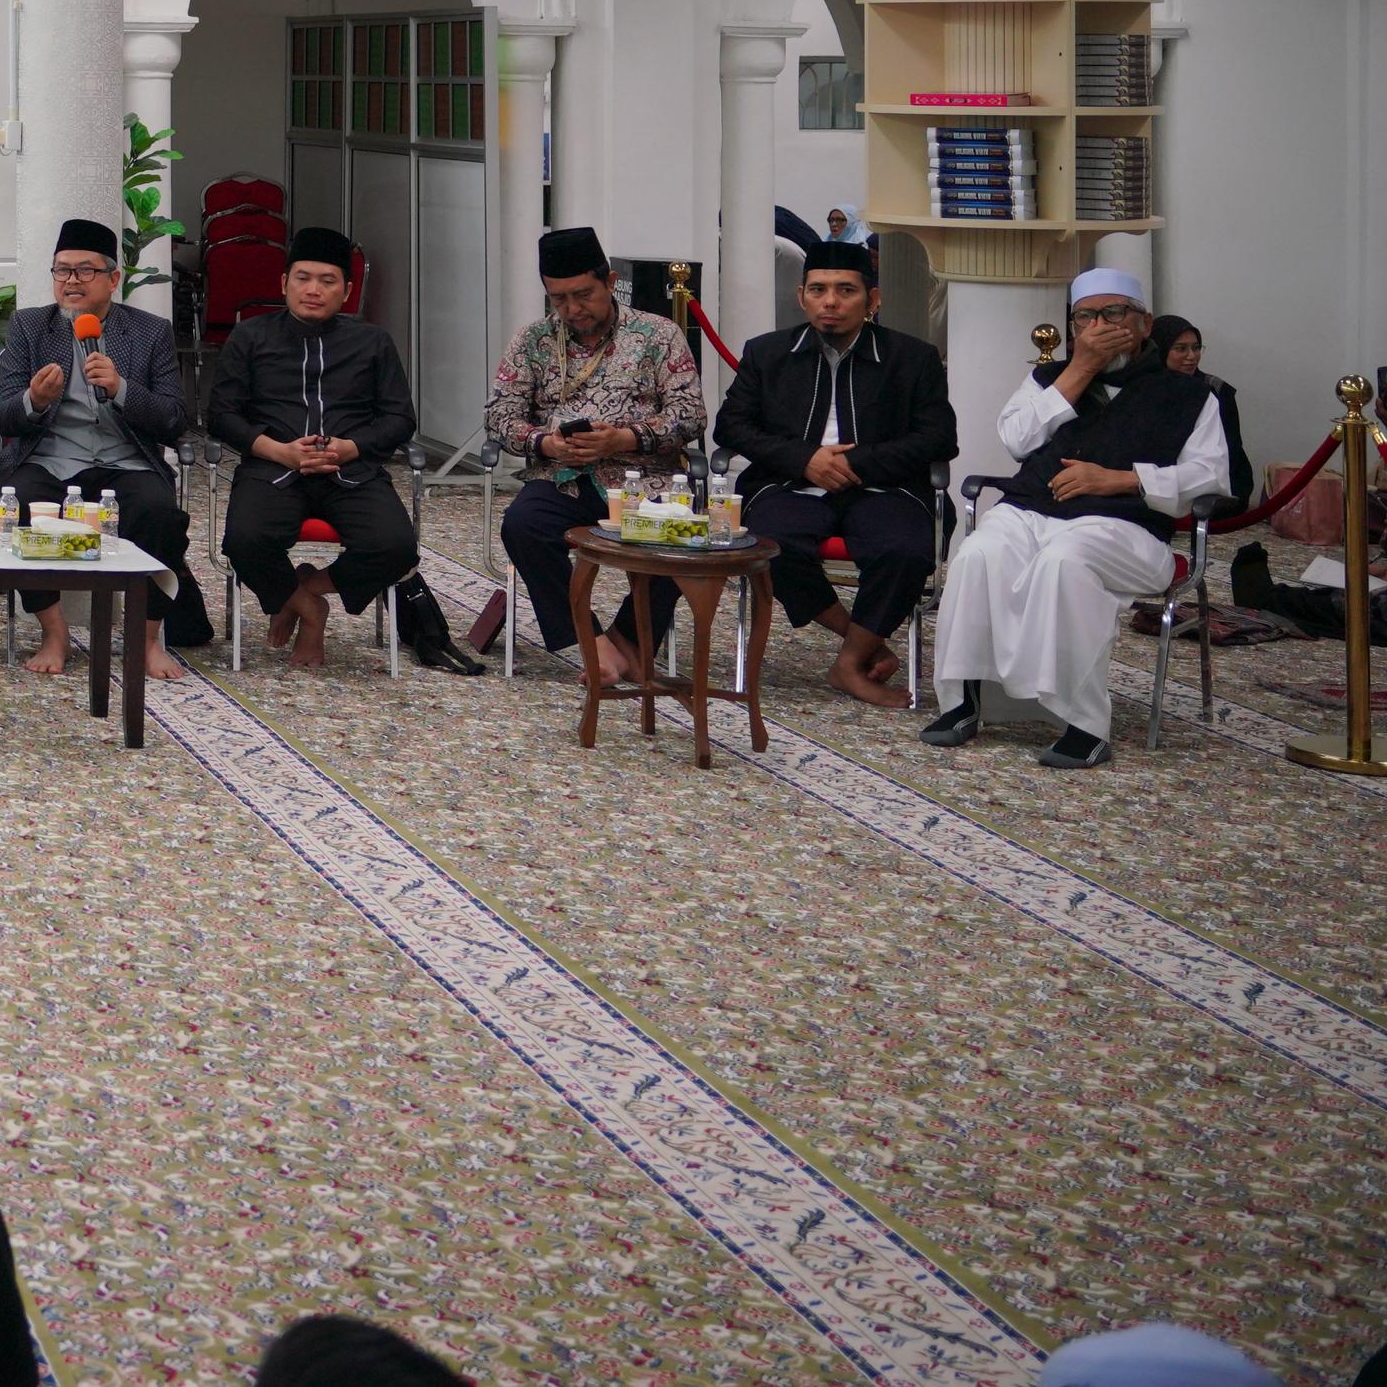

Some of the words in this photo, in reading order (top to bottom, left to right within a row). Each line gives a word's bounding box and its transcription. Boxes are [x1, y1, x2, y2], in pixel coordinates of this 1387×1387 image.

[614, 279, 633, 294] ABUNG
[624, 518, 665, 531] PREMIER
[26, 537, 61, 546] PREMIER
